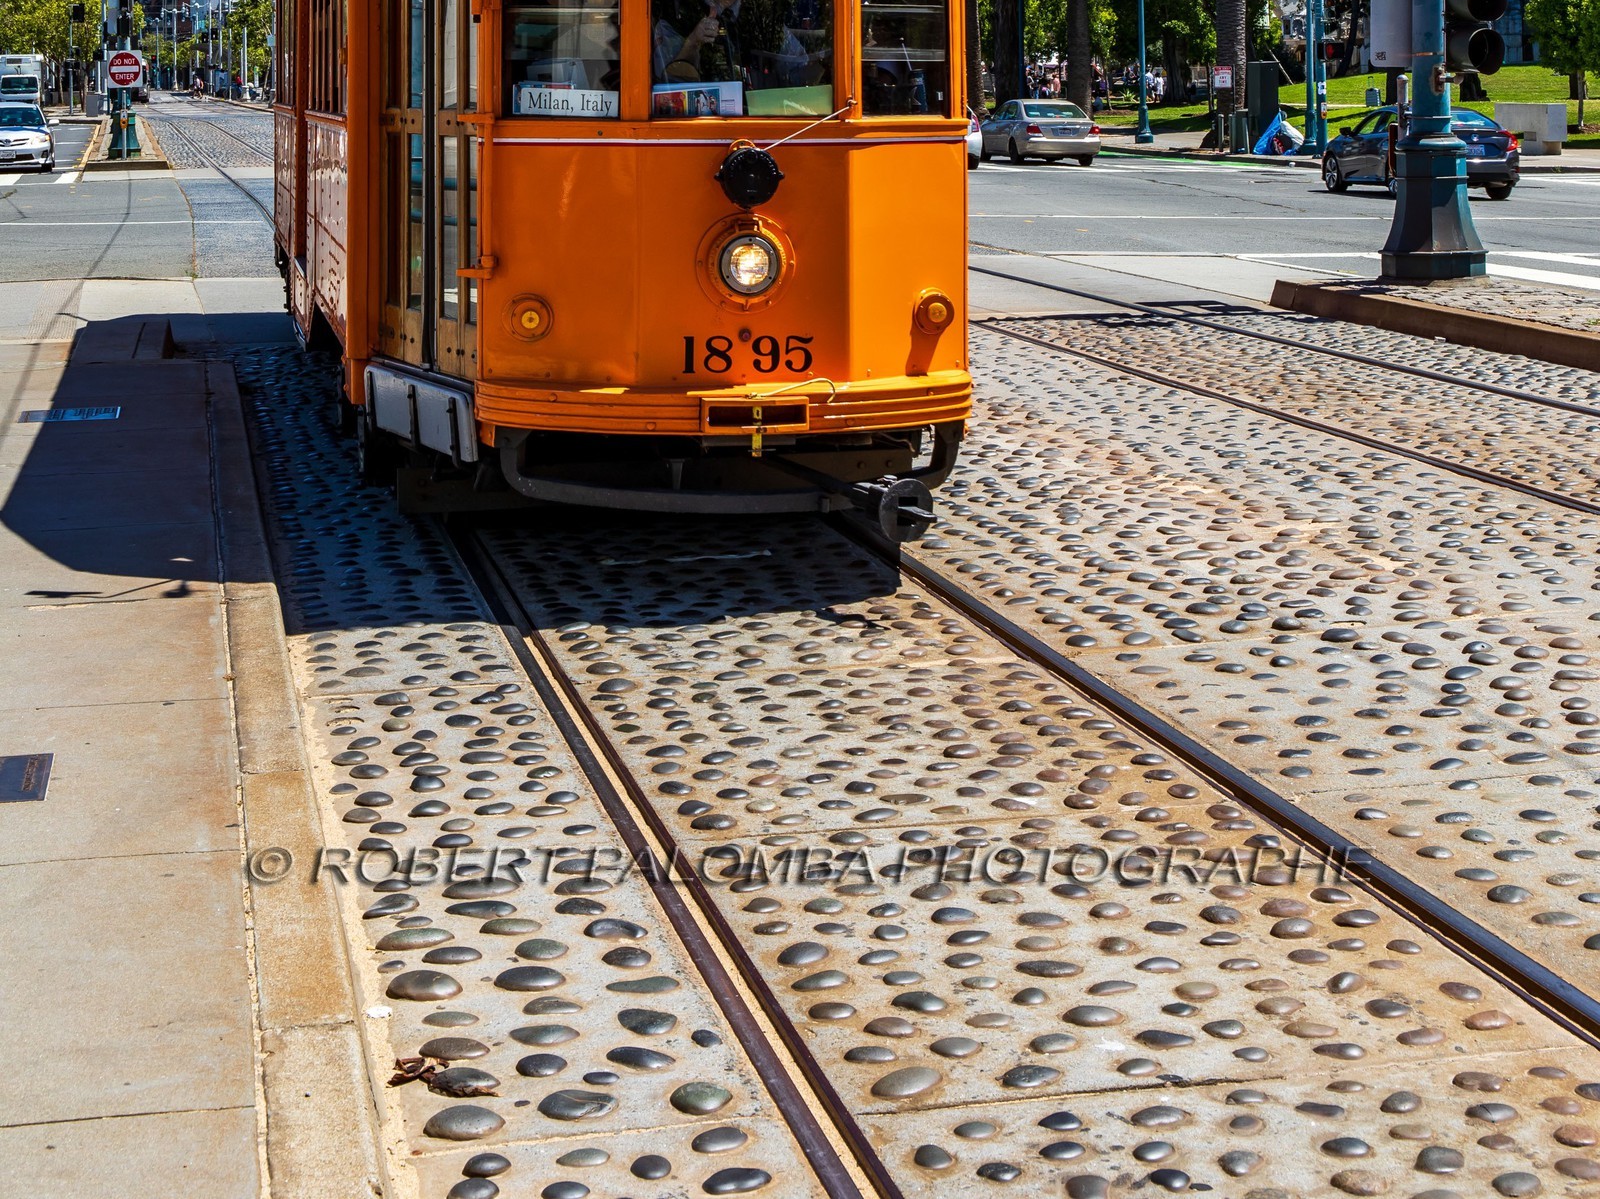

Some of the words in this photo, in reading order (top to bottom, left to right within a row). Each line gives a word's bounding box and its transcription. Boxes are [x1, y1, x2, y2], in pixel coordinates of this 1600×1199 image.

[528, 92, 574, 112] Milan,
[580, 93, 613, 116] Italy
[682, 335, 814, 374] 1895
